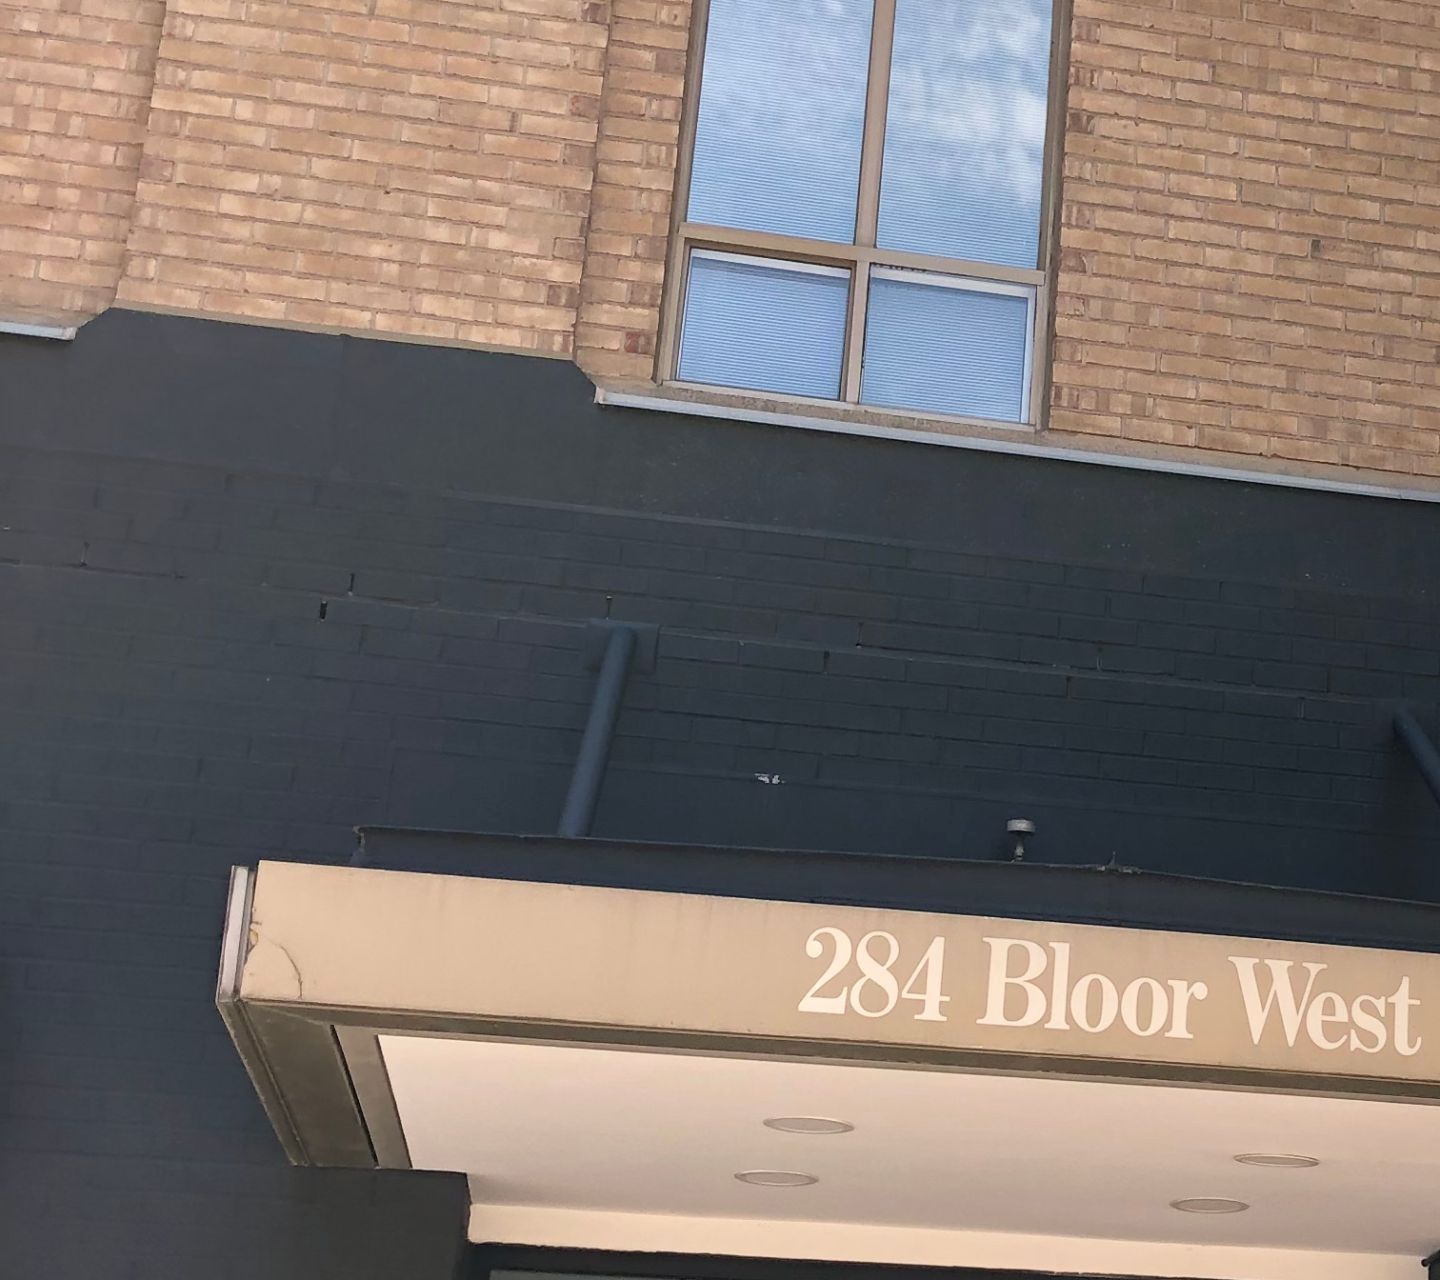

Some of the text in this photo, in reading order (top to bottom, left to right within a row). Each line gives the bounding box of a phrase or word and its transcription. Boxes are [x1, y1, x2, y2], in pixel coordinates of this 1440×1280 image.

[798, 927, 1423, 1056] 284 Bloor West
